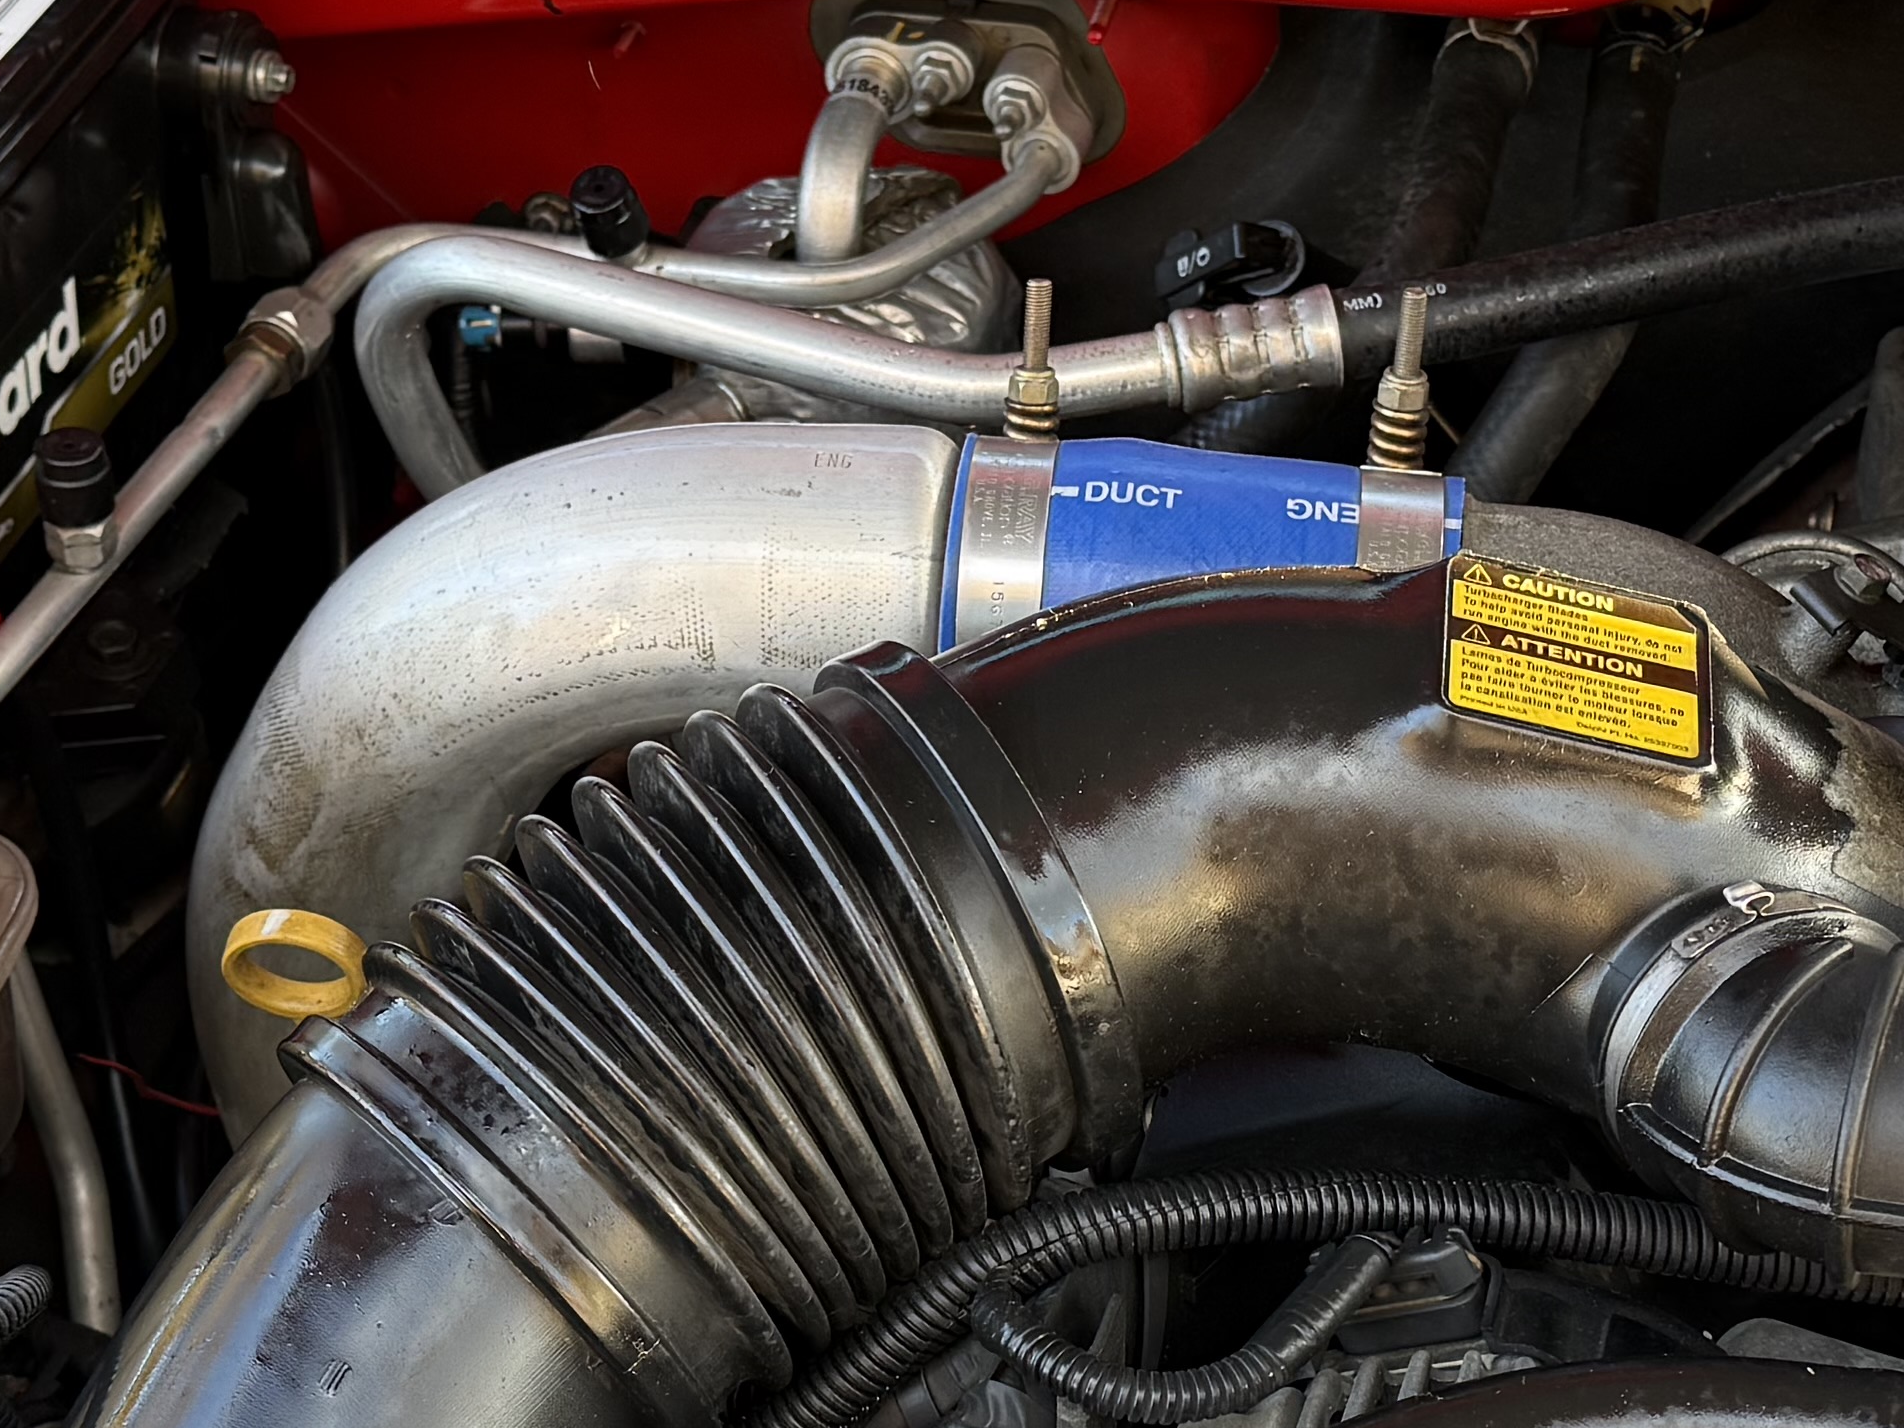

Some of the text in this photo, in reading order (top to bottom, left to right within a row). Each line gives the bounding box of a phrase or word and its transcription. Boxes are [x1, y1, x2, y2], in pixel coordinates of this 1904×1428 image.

[108, 305, 167, 396] GOLD
[1084, 480, 1360, 525] DUCT ENG
[1501, 573, 1615, 613] CAUTION
[1463, 595, 1683, 654] To help avoid personal injury, do not
[1463, 608, 1484, 619] run
[1486, 614, 1527, 630] engine
[1531, 623, 1558, 638] with
[1560, 630, 1580, 641] the
[1583, 634, 1610, 649] duct
[1461, 646, 1503, 664] Lames
[1506, 657, 1522, 669] de
[1500, 633, 1644, 679] ATTENTION
[1460, 681, 1473, 692] la
[1475, 685, 1552, 711] canalisation
[1555, 702, 1575, 715] est
[1460, 671, 1483, 683] pas
[1487, 674, 1516, 690] faire
[1519, 683, 1565, 702] tourner
[1583, 698, 1629, 717] moteur
[1631, 708, 1679, 728] lorsque
[1461, 657, 1490, 673] Pour
[1494, 666, 1526, 680] aider
[1579, 684, 1599, 698] les
[1669, 706, 1686, 718] ne
